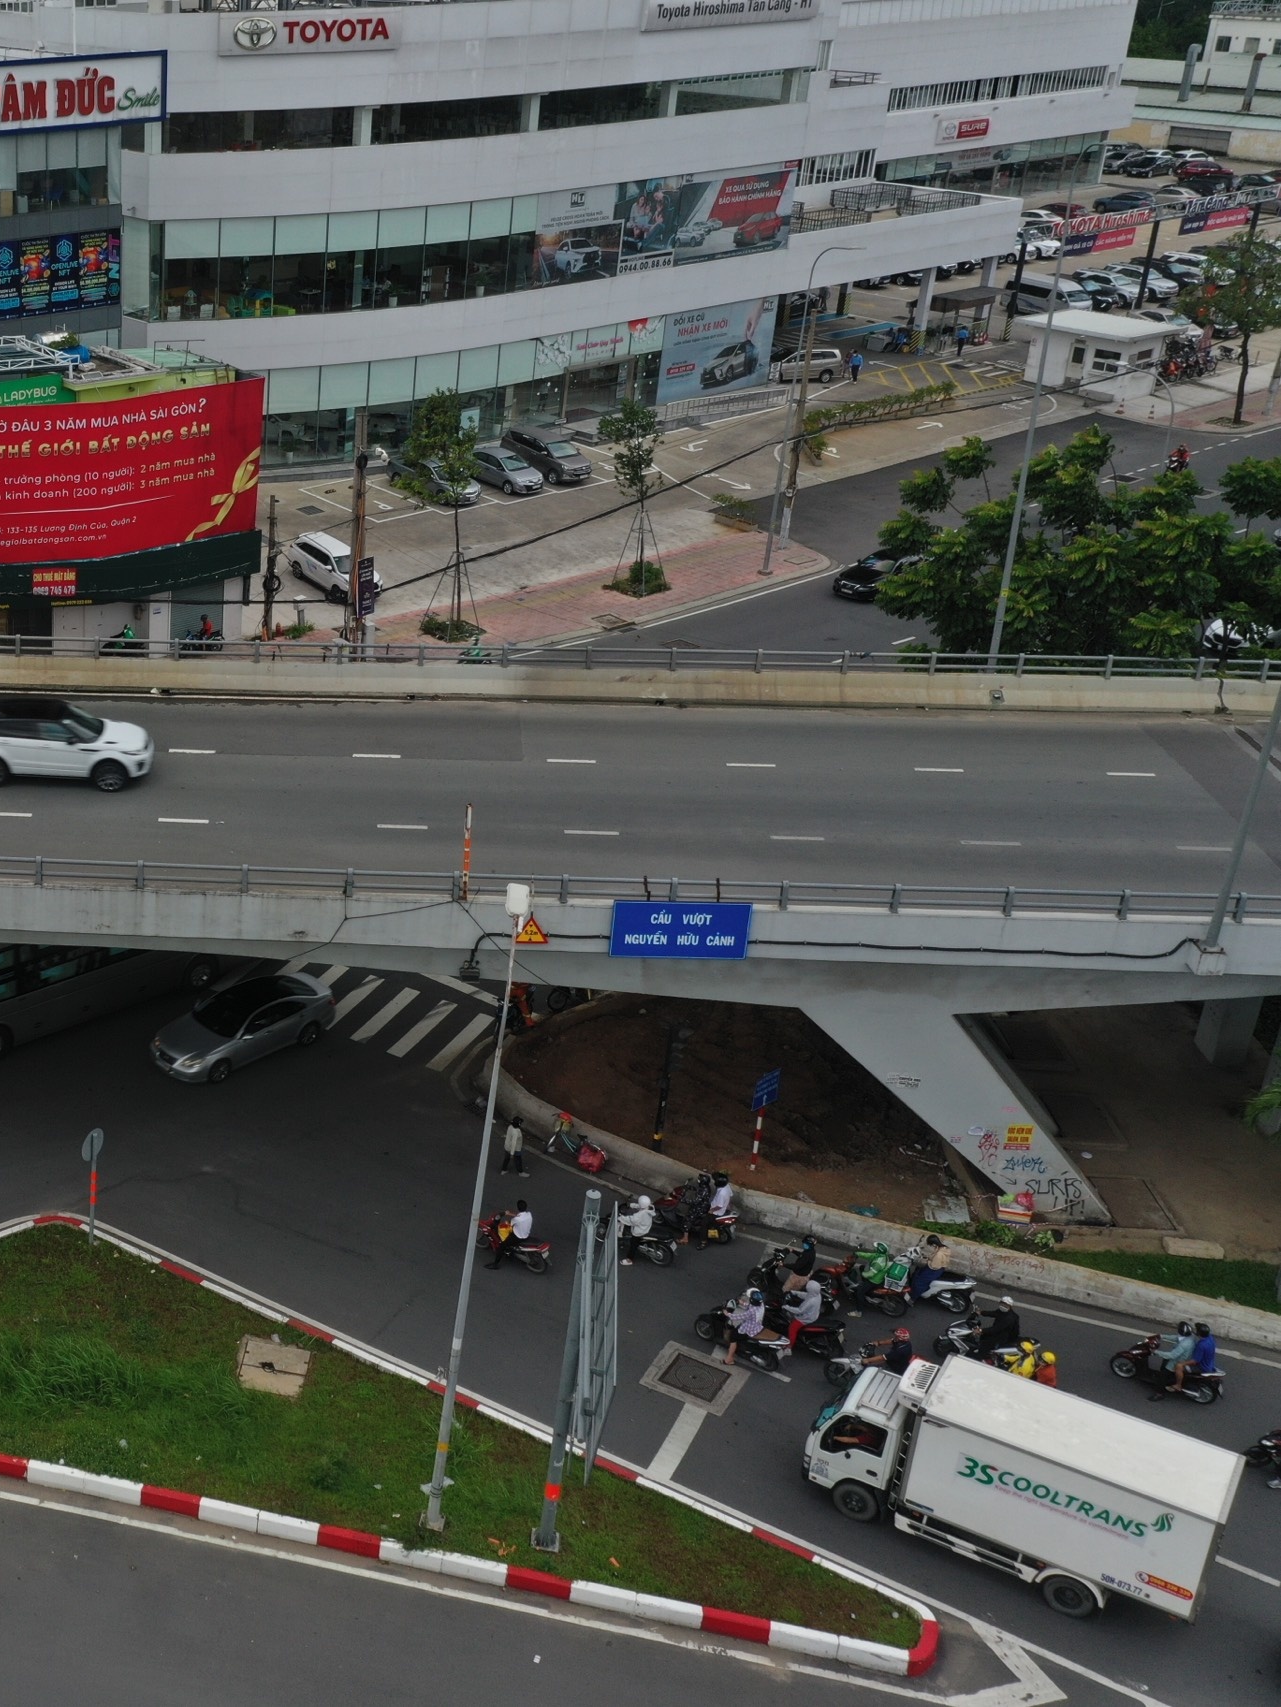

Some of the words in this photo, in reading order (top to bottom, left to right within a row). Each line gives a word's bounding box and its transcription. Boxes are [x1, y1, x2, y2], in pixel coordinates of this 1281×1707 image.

[657, 4, 690, 22] Toyota
[693, 0, 744, 17] Hiroshima
[283, 18, 389, 43] TOYOTA
[56, 67, 115, 117] ĐỨC
[117, 86, 160, 111] Smile
[733, 185, 744, 193] QUA
[753, 180, 769, 191] DỤNG
[51, 261, 79, 270] OPENLIVE
[108, 234, 120, 279] NFT
[618, 257, 672, 274] 0944.00.88.66
[0, 277, 12, 285] NFT
[673, 316, 685, 326] ĐỔI
[687, 316, 695, 324] XE
[695, 312, 705, 322] CŨ
[677, 324, 700, 338] NHẬN
[702, 322, 712, 333] XE
[713, 317, 729, 331] MỚI
[4, 386, 57, 403] LADYBUG
[11, 419, 40, 432] ĐÂU
[44, 420, 52, 431] 3
[57, 417, 86, 430] NĂM
[91, 415, 119, 429] MUA
[122, 409, 147, 425] NHÀ
[150, 406, 167, 420] SÀI
[38, 438, 81, 457] GIỚI
[88, 434, 120, 454] BẤT
[126, 429, 174, 451] ĐỘNG
[180, 421, 211, 440] SẢN
[140, 465, 147, 474] 2
[149, 461, 171, 472] năm
[174, 458, 195, 468] mua
[198, 452, 216, 463] nhà
[4, 475, 42, 487] trưởng
[45, 472, 81, 485] phòng
[84, 471, 99, 482] (10
[102, 466, 135, 480] người):
[140, 480, 146, 489] 3
[149, 476, 170, 488] năm
[173, 473, 194, 483] mua
[197, 467, 215, 479] nhà
[5, 490, 30, 500] kinh
[33, 489, 69, 499] doanh
[73, 487, 97, 499] (200
[101, 482, 135, 496] người):
[6, 525, 38, 535] 133-135
[40, 524, 66, 534] Lương
[69, 522, 87, 533] Định
[110, 518, 130, 528] Quận
[650, 909, 671, 925] CẦU
[682, 912, 712, 926] VƯỢT
[624, 930, 668, 945] NGUYỄN
[677, 931, 699, 946] HỮU
[706, 931, 735, 947] CẢNH
[1025, 1178, 1083, 1199] SURFS
